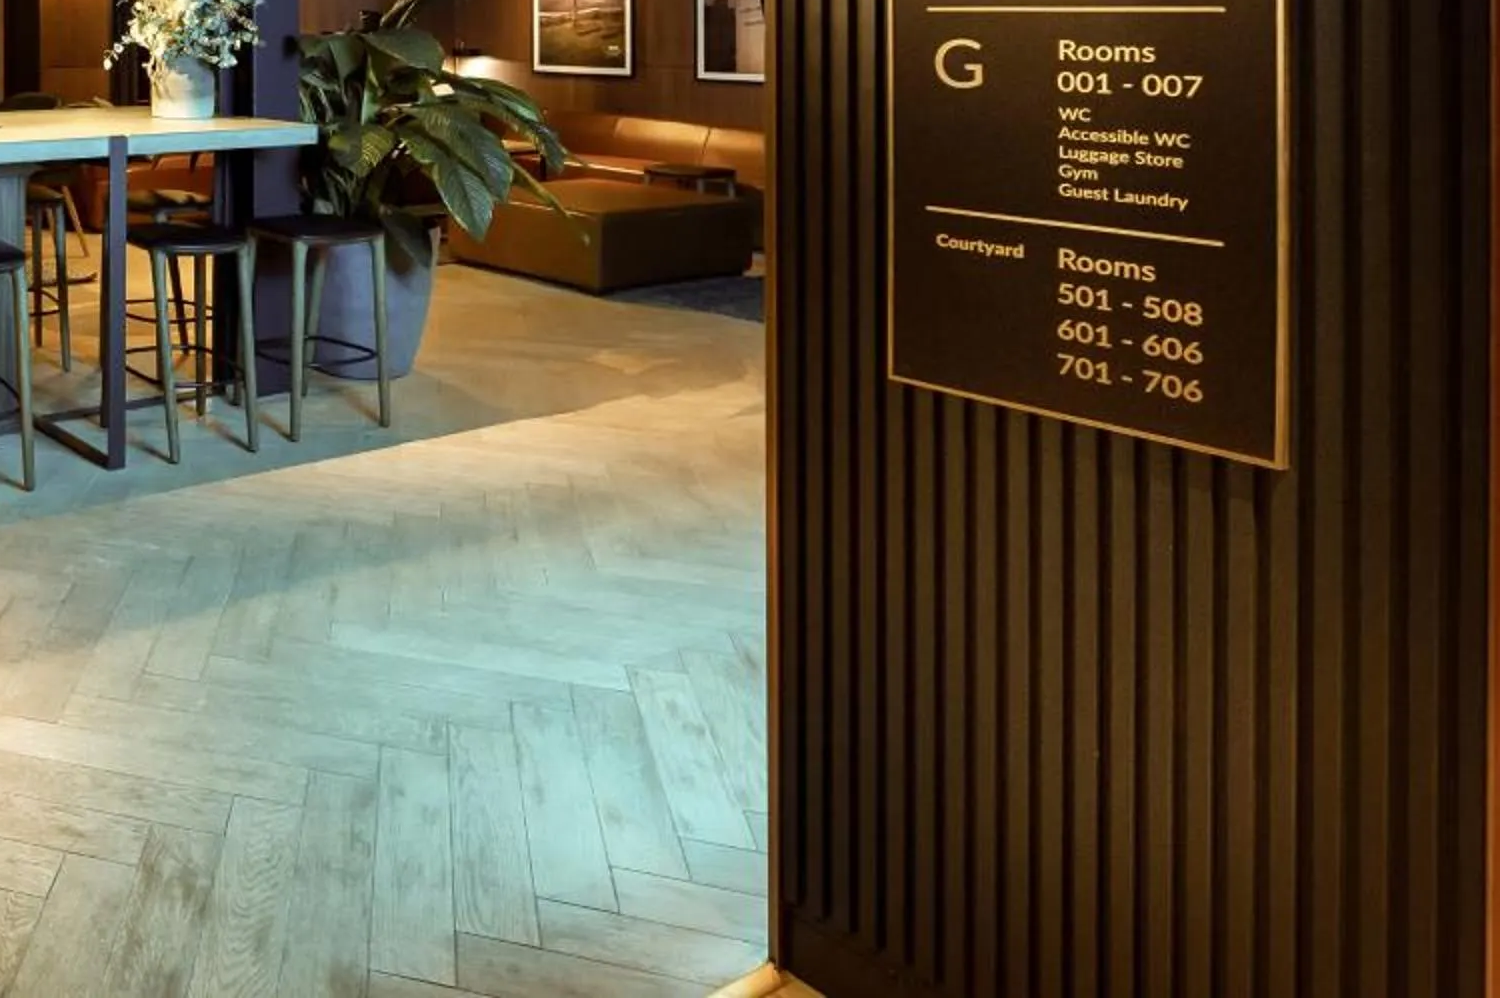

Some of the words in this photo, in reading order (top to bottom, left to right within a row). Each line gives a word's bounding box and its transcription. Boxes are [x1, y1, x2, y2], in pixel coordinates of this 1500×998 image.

[934, 38, 984, 89] G
[1058, 39, 1157, 64] Rooms
[1056, 70, 1112, 95] 001
[1141, 73, 1204, 99] 007
[1057, 106, 1092, 123] WC
[1057, 126, 1150, 146] Accessible
[1153, 131, 1191, 149] WC
[1058, 145, 1130, 166] Luggage
[1134, 150, 1184, 169] Store
[1057, 163, 1099, 182] Gym
[1057, 182, 1109, 202] Guest
[1113, 188, 1189, 212] Laundry
[935, 232, 1025, 259] Courtyard
[1057, 247, 1157, 283] Rooms
[1057, 281, 1113, 312] 501
[1142, 295, 1204, 327] 508
[1056, 318, 1113, 349] 601
[1142, 334, 1204, 365] 606
[1056, 352, 1112, 385] 701
[1142, 369, 1204, 403] 706
